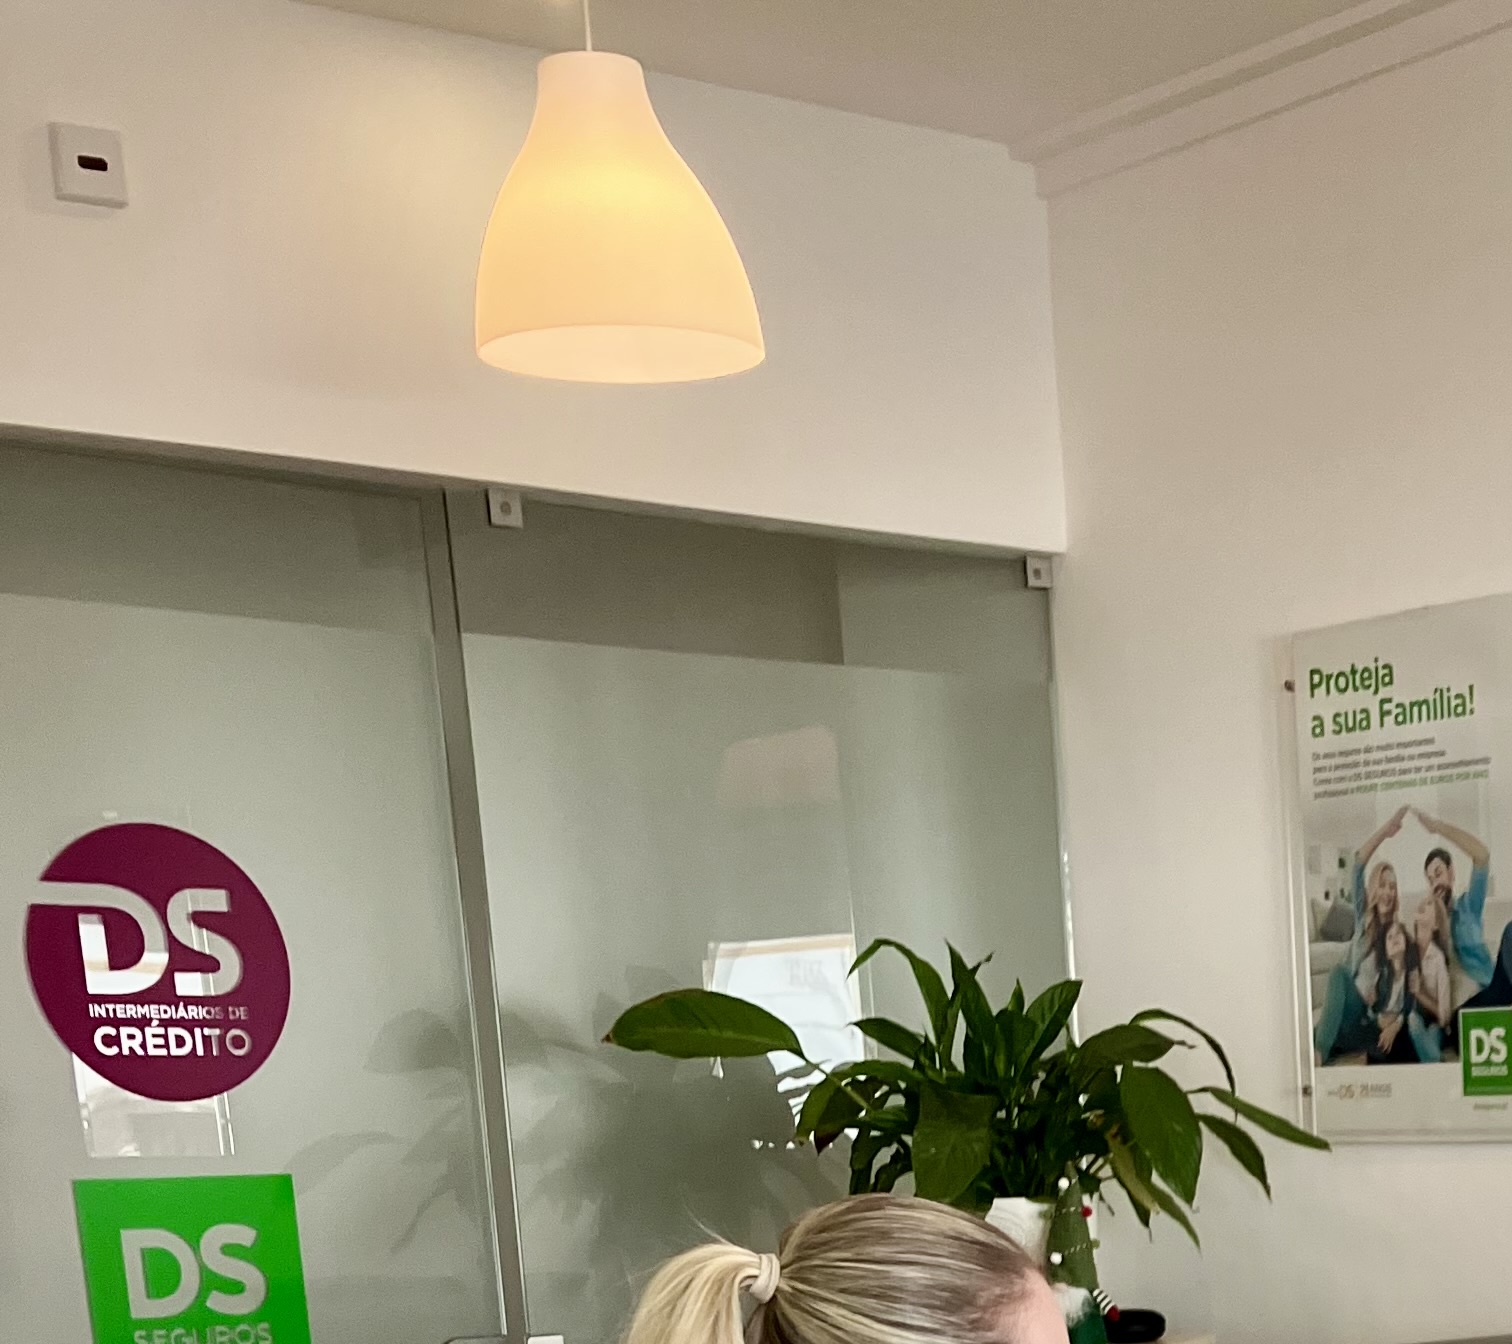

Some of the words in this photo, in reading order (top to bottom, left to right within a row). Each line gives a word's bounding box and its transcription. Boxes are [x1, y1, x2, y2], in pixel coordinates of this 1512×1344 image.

[1309, 657, 1394, 698] Proteja
[1311, 714, 1325, 739] a
[1332, 707, 1372, 736] sua
[1379, 684, 1475, 729] Família!
[40, 882, 243, 997] DS
[88, 1002, 224, 1021] INTERMEDIÁRIOS
[228, 1006, 249, 1021] DE
[93, 1019, 252, 1057] CRÉDITO
[1470, 1028, 1507, 1064] DS
[120, 1223, 268, 1320] DS
